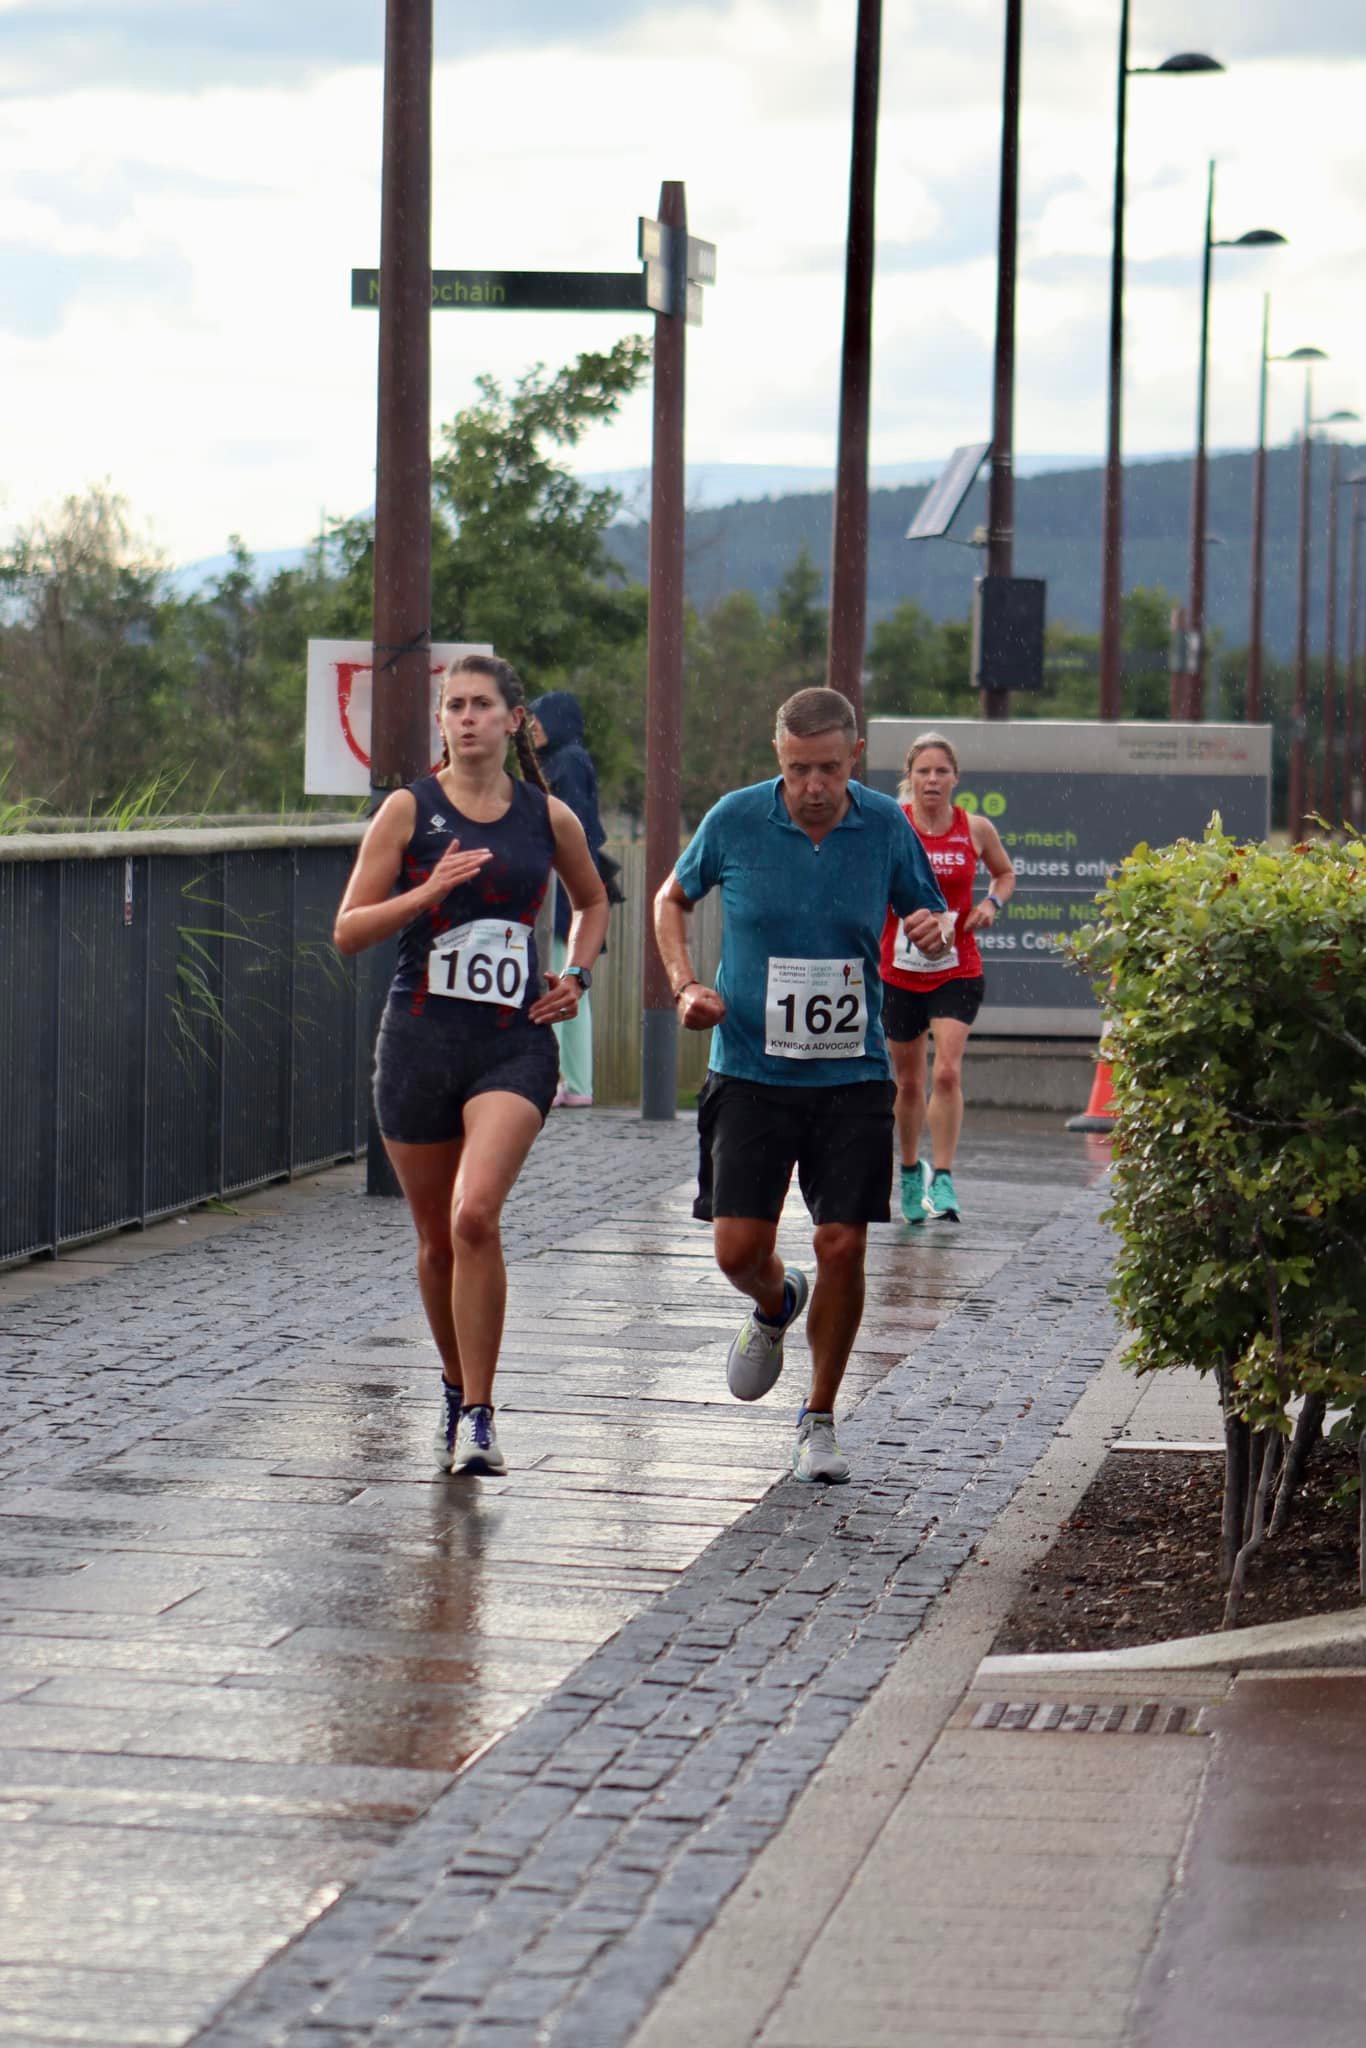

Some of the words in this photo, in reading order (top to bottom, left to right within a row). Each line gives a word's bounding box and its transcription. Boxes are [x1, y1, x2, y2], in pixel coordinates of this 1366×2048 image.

[927, 852, 966, 866] RES
[1013, 858, 1070, 876] Buses
[1007, 904, 1063, 920] Inbhir
[974, 935, 1016, 949] ness
[440, 950, 521, 999] 160
[777, 993, 859, 1035] 162
[771, 1039, 811, 1051] KYNISKA
[812, 1041, 860, 1050] ADVOCACY
